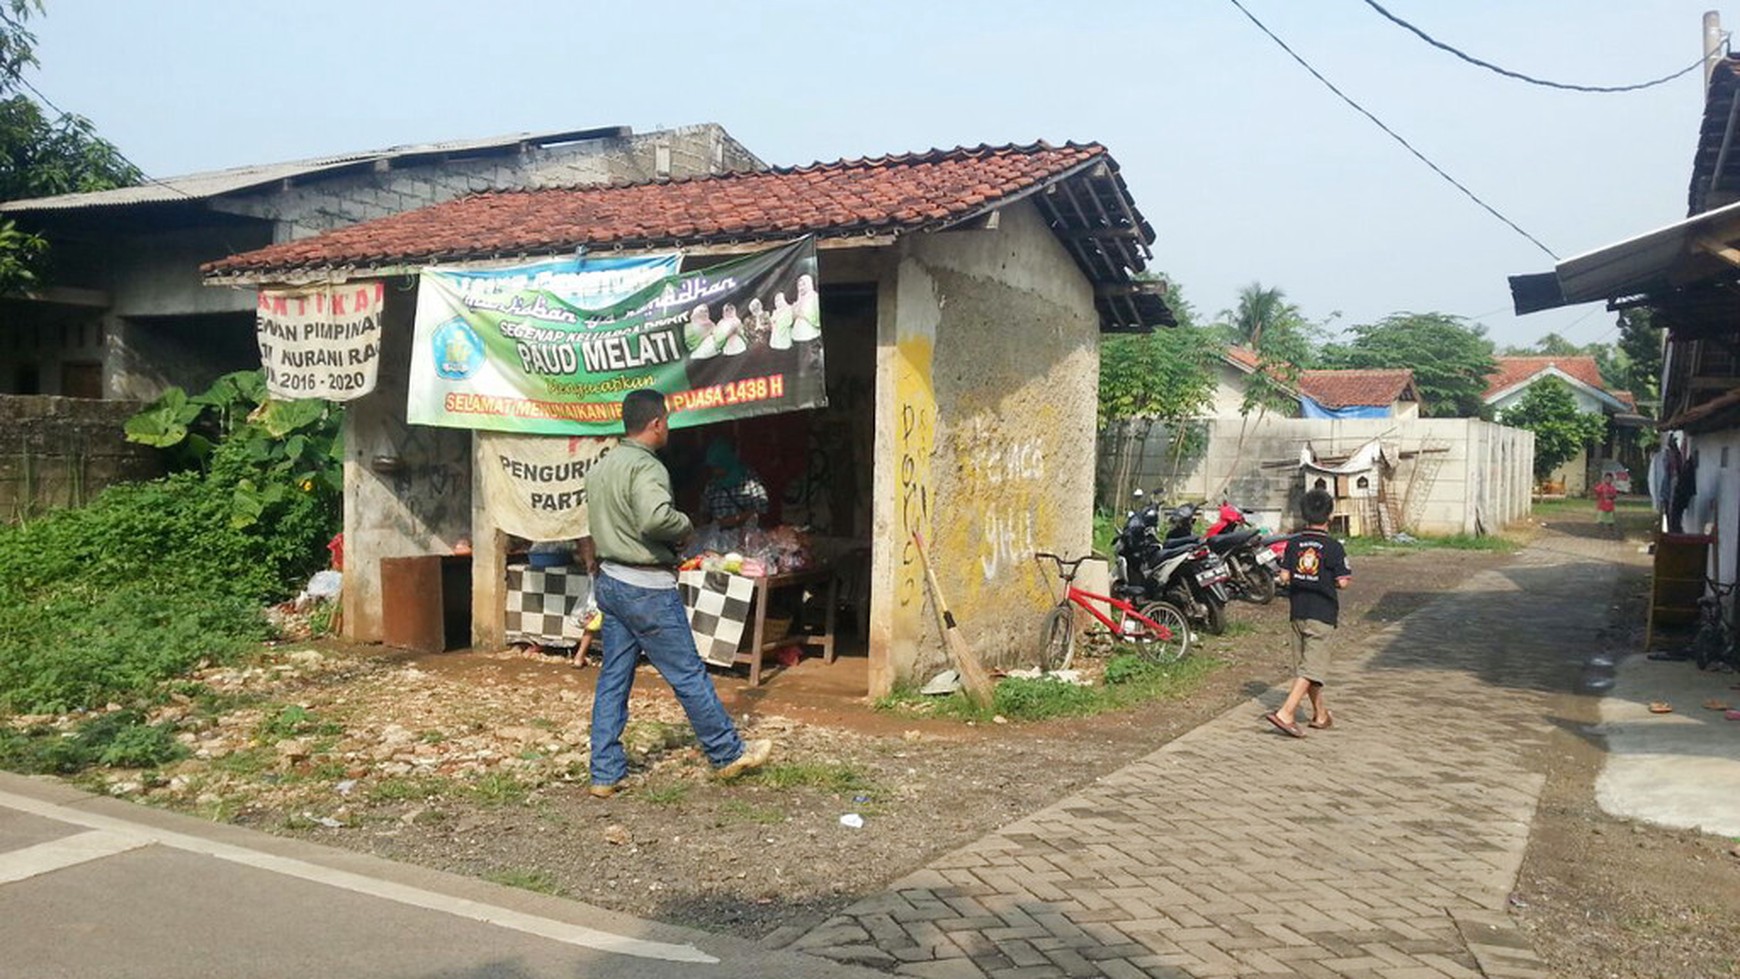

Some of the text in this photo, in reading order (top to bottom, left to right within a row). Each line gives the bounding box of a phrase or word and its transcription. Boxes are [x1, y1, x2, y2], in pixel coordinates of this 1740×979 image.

[500, 320, 564, 342] SEGENAP
[281, 350, 343, 368] NURANI
[516, 330, 682, 375] PAUD MELATI
[280, 373, 316, 390] 2016
[328, 371, 366, 391] 2020
[445, 393, 511, 415] SELAMAT
[672, 387, 725, 412] PUASA
[725, 380, 768, 403] 1438
[769, 374, 784, 399] H
[531, 489, 589, 511] PART
